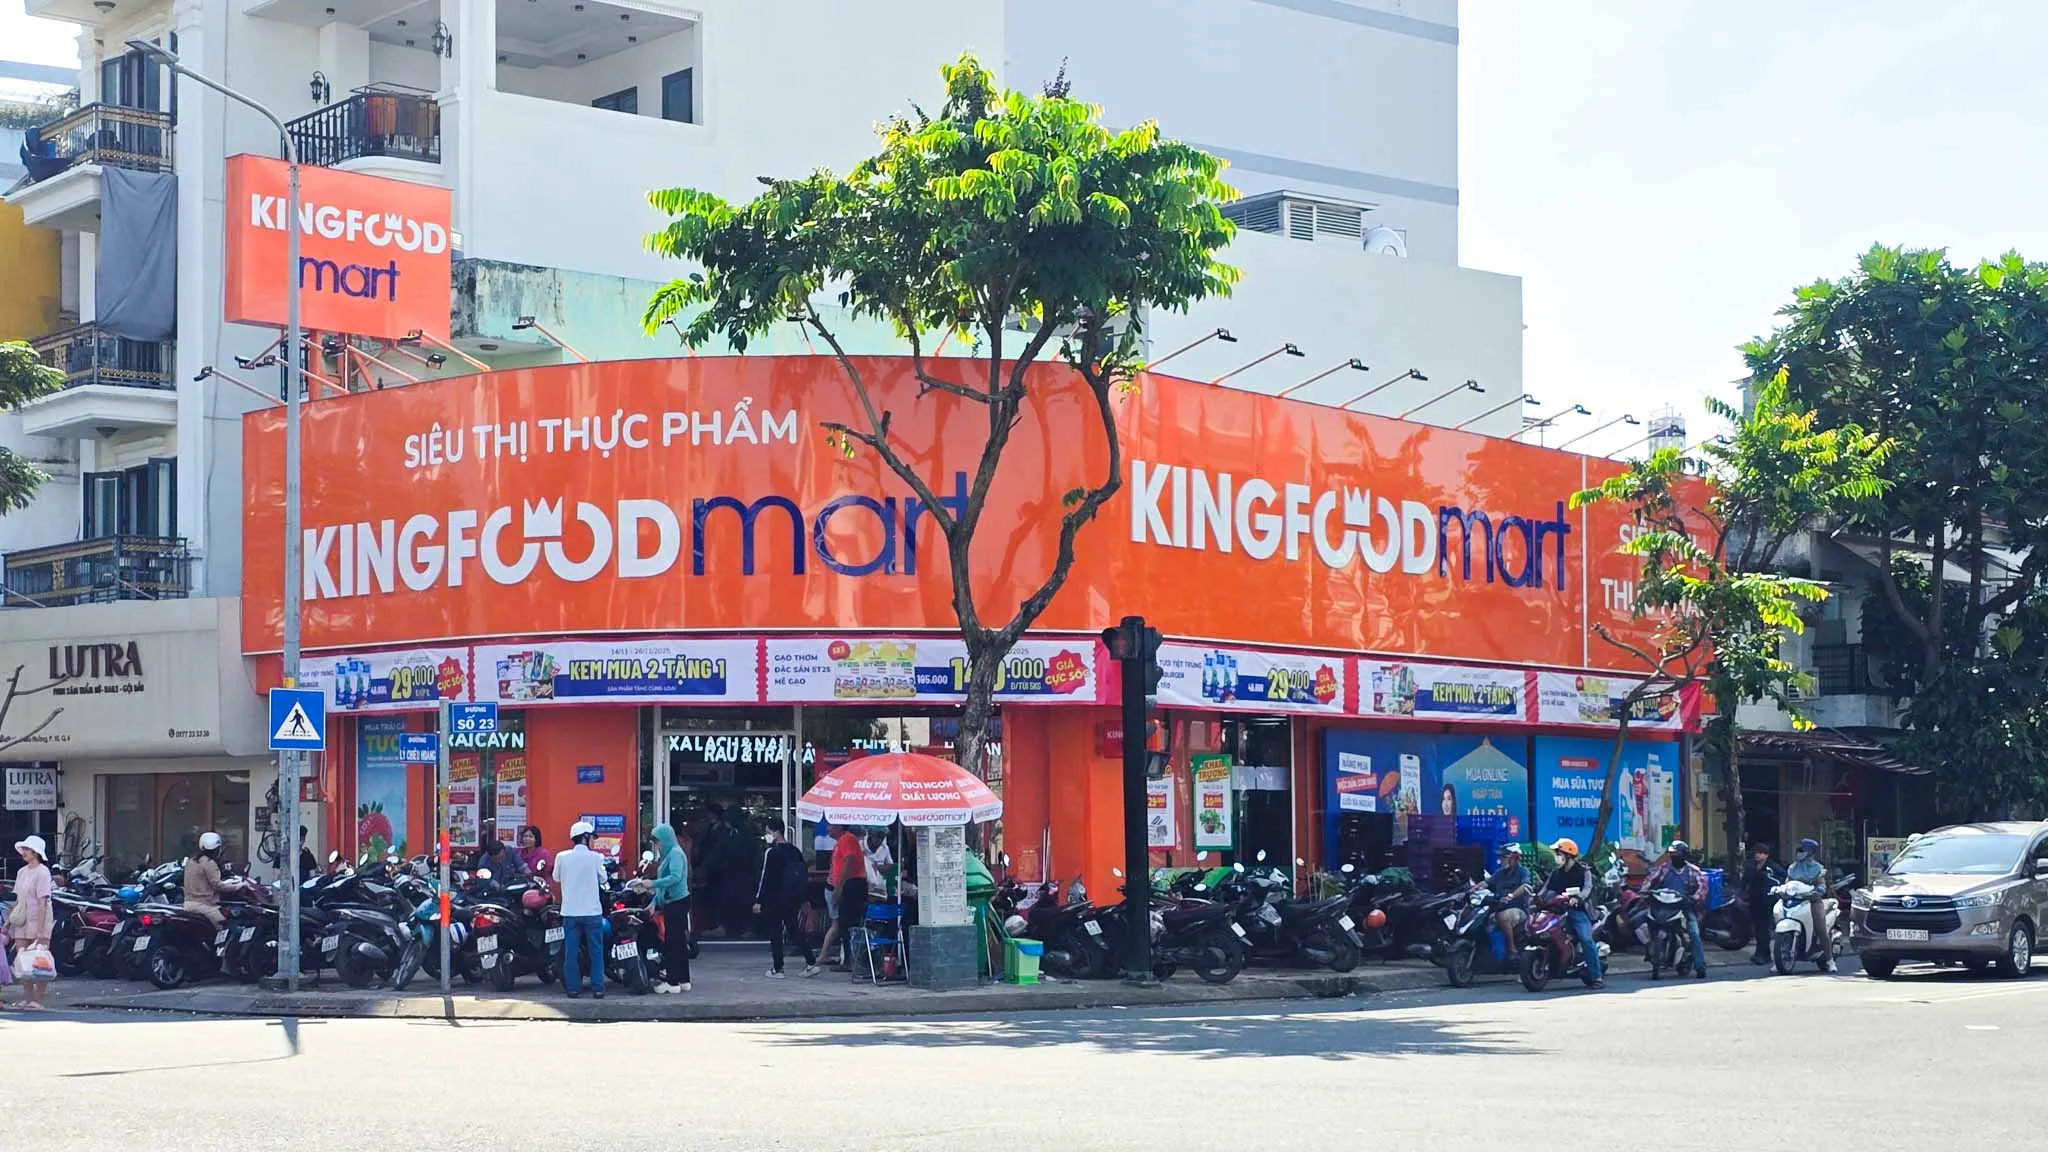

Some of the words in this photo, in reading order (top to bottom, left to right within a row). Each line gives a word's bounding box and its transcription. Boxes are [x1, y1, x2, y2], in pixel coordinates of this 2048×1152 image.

[251, 193, 447, 255] KINGFOOD
[299, 255, 400, 302] mart
[404, 425, 464, 470] SIÊU
[473, 422, 528, 464] THỊ
[539, 407, 649, 459] THỰC
[662, 396, 798, 447] PHẨM
[303, 496, 681, 601] KINGFOOD
[693, 471, 969, 577] mart
[1131, 460, 1436, 575] KINGFOOD
[1439, 501, 1572, 592] mart
[49, 641, 144, 679] LUTRA
[569, 659, 604, 682] KEM
[607, 658, 644, 681] MUA
[646, 658, 660, 680] 2
[663, 654, 713, 686] TẶNG
[717, 657, 728, 682] 1
[1056, 659, 1074, 670] GIÁ
[390, 664, 436, 700] 29.000
[1045, 673, 1068, 686] CỰC
[1069, 668, 1090, 680] SỐC
[1267, 667, 1310, 700] 29.000
[1432, 681, 1454, 704] KEM
[1455, 682, 1476, 704] MUA
[1477, 683, 1486, 705] 2
[1486, 680, 1511, 713] TẶNG
[457, 714, 475, 730] SỐ
[479, 718, 495, 730] 23
[9, 772, 53, 786] LUTRA
[924, 779, 953, 789] NGON
[1552, 777, 1570, 790] MUA
